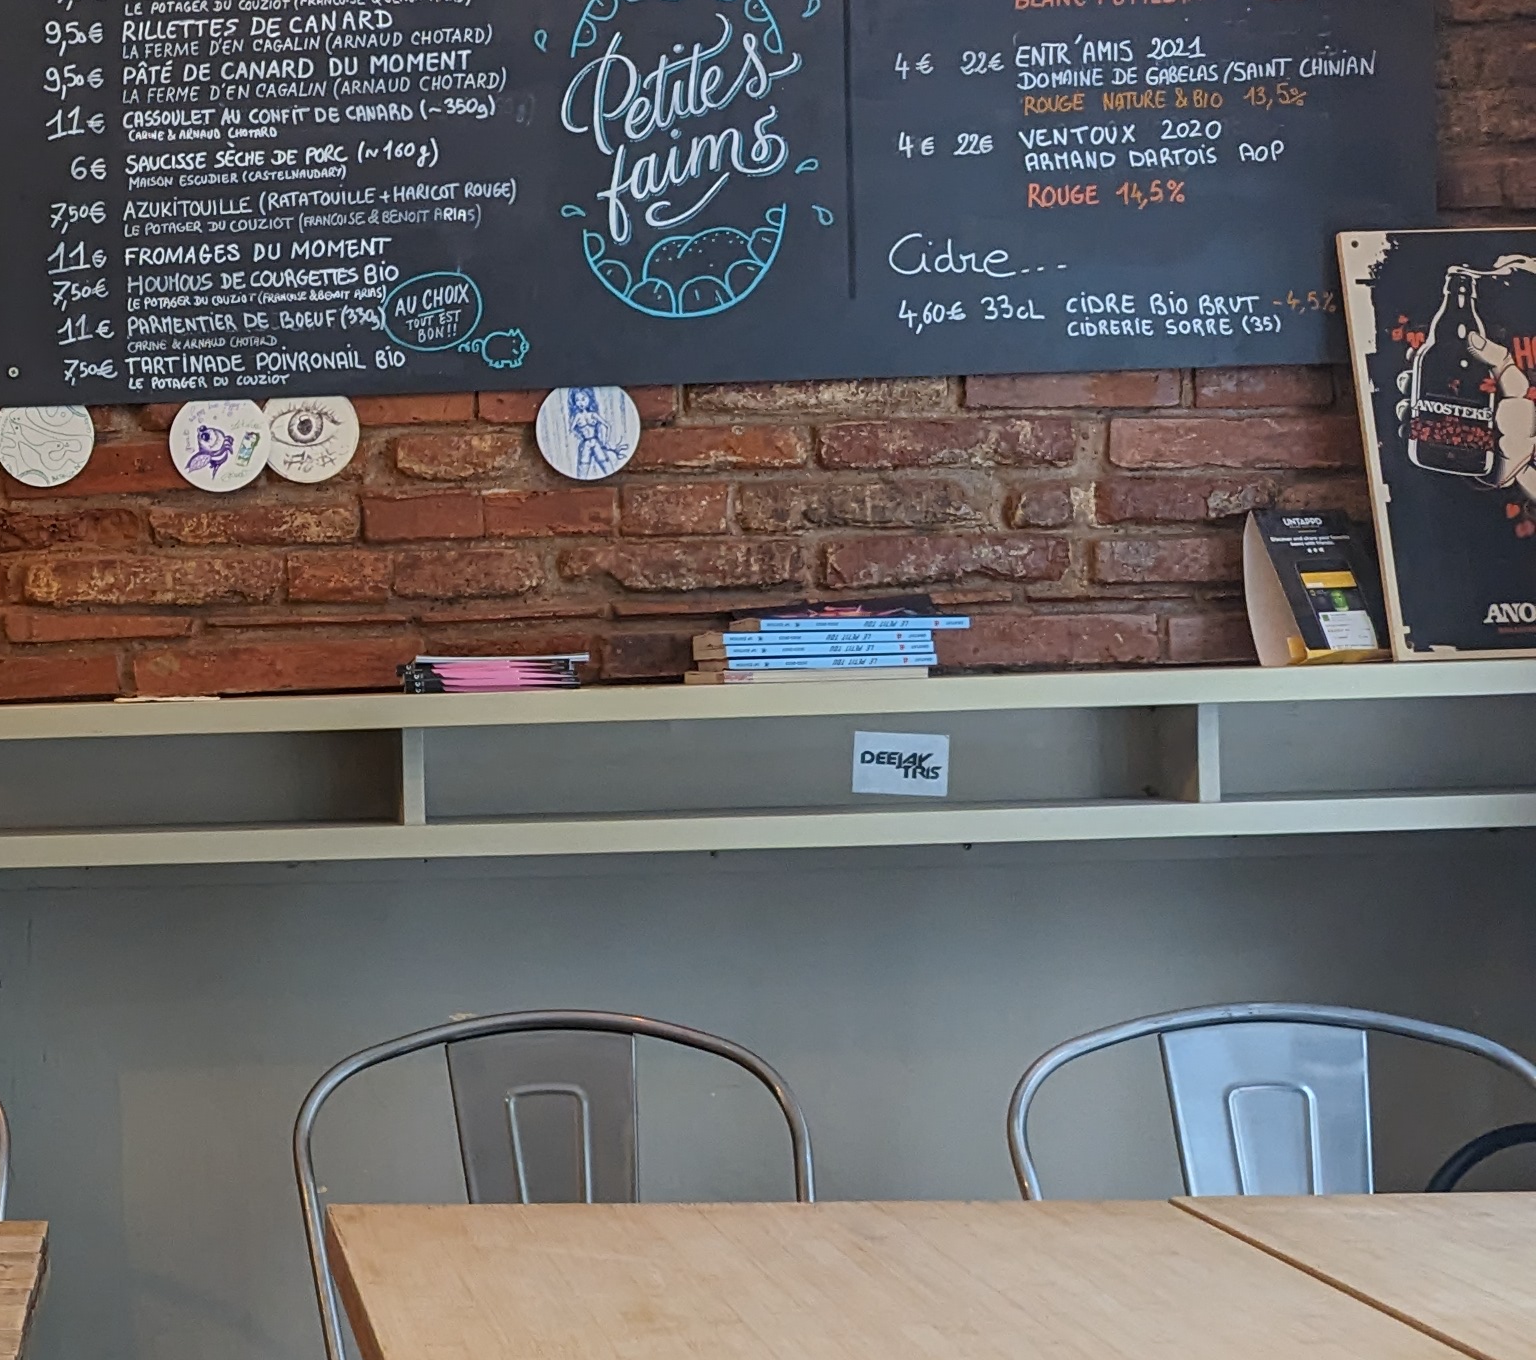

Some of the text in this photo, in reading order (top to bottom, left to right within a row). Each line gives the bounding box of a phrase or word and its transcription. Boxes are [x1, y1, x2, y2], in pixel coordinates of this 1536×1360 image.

[122, 19, 242, 45] RILLETTES
[250, 17, 281, 37] DE
[289, 9, 392, 33] CANARD
[123, 50, 471, 85] PÂTÉ DE CANARD DU MOMENT
[1019, 120, 1221, 149] VENTOUX 2020
[125, 152, 207, 174] SAUCISSE
[1029, 180, 1184, 209] ROUGE 14,5%
[125, 238, 391, 266] FROMAGES DU MOMENT
[395, 284, 469, 316] AU CHOIX
[1068, 315, 1281, 336] CIDRERIE SORRE (35)
[1484, 603, 1536, 623] ANO
[861, 751, 933, 769] DEEJAY
[902, 765, 941, 779] TRIS
